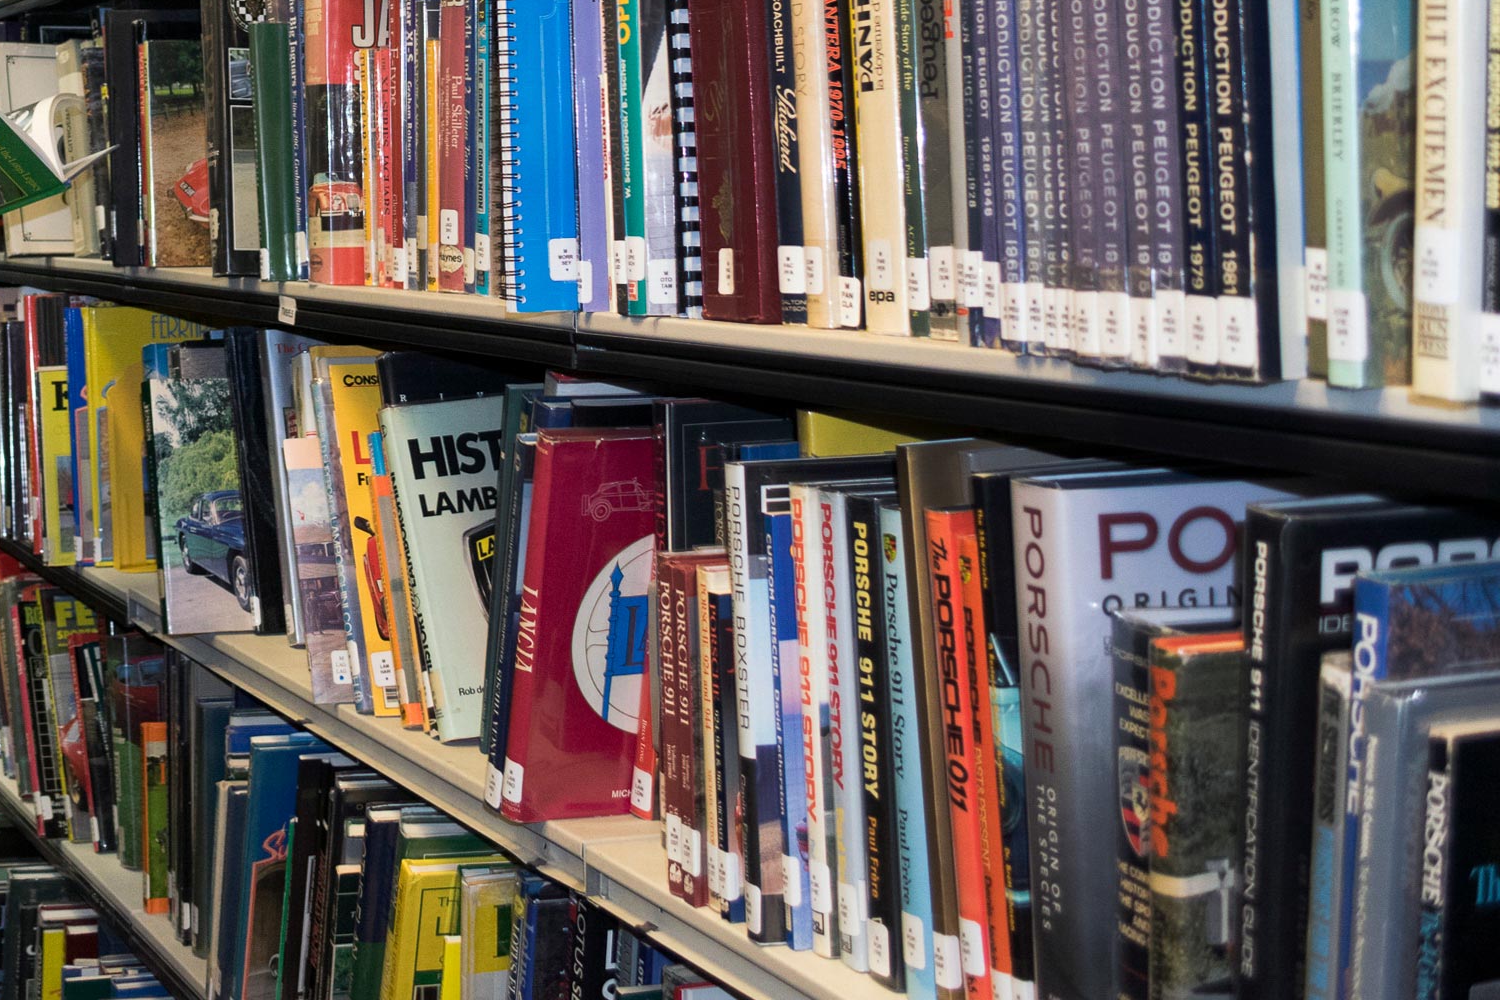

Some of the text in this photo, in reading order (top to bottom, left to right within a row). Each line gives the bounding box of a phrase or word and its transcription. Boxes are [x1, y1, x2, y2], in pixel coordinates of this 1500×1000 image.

[288, 13, 298, 33] Big
[289, 37, 299, 86] Jaguars
[450, 75, 462, 149] Paul Skilleter
[828, 80, 846, 170] 1970-1995
[977, 47, 988, 119] PEUGEOT
[1329, 71, 1346, 161] BRIERLEY
[773, 85, 797, 175] Packard
[477, 148, 485, 210] COMPANION
[1153, 120, 1170, 234] PEUGEOT
[1185, 123, 1202, 229] PEUGEOT
[1217, 127, 1235, 235] PEUGEOT
[868, 289, 896, 304] epa
[1190, 243, 1204, 290] 1979
[1222, 250, 1238, 295] 1981
[1418, 320, 1448, 336] RUN
[853, 522, 872, 641] PORSCHE
[1099, 506, 1237, 580] PO
[515, 584, 539, 675] LANCIA
[660, 581, 676, 716] PORSCHE 911
[732, 486, 750, 730] PORSCHE BOXSTER
[819, 503, 844, 791] PORSCHE 911 STORY
[884, 573, 899, 665] Porsche
[458, 686, 476, 696] Rob
[675, 589, 691, 726] PORSCHE 911
[790, 499, 817, 823] PORSCHE 911 STORY
[859, 657, 873, 703] 911
[890, 670, 903, 706] 911
[892, 714, 907, 780] Story
[1023, 506, 1062, 914] PORSCHE ORIGIN OF
[861, 712, 880, 800] STORY
[1240, 541, 1268, 978] PORSCHE 911 IDENTIFICATION GUIDE
[867, 816, 879, 853] Paul
[897, 809, 909, 853] Paul
[1035, 784, 1053, 932] THE SPECIES
[1420, 772, 1446, 906] PORSCHE
